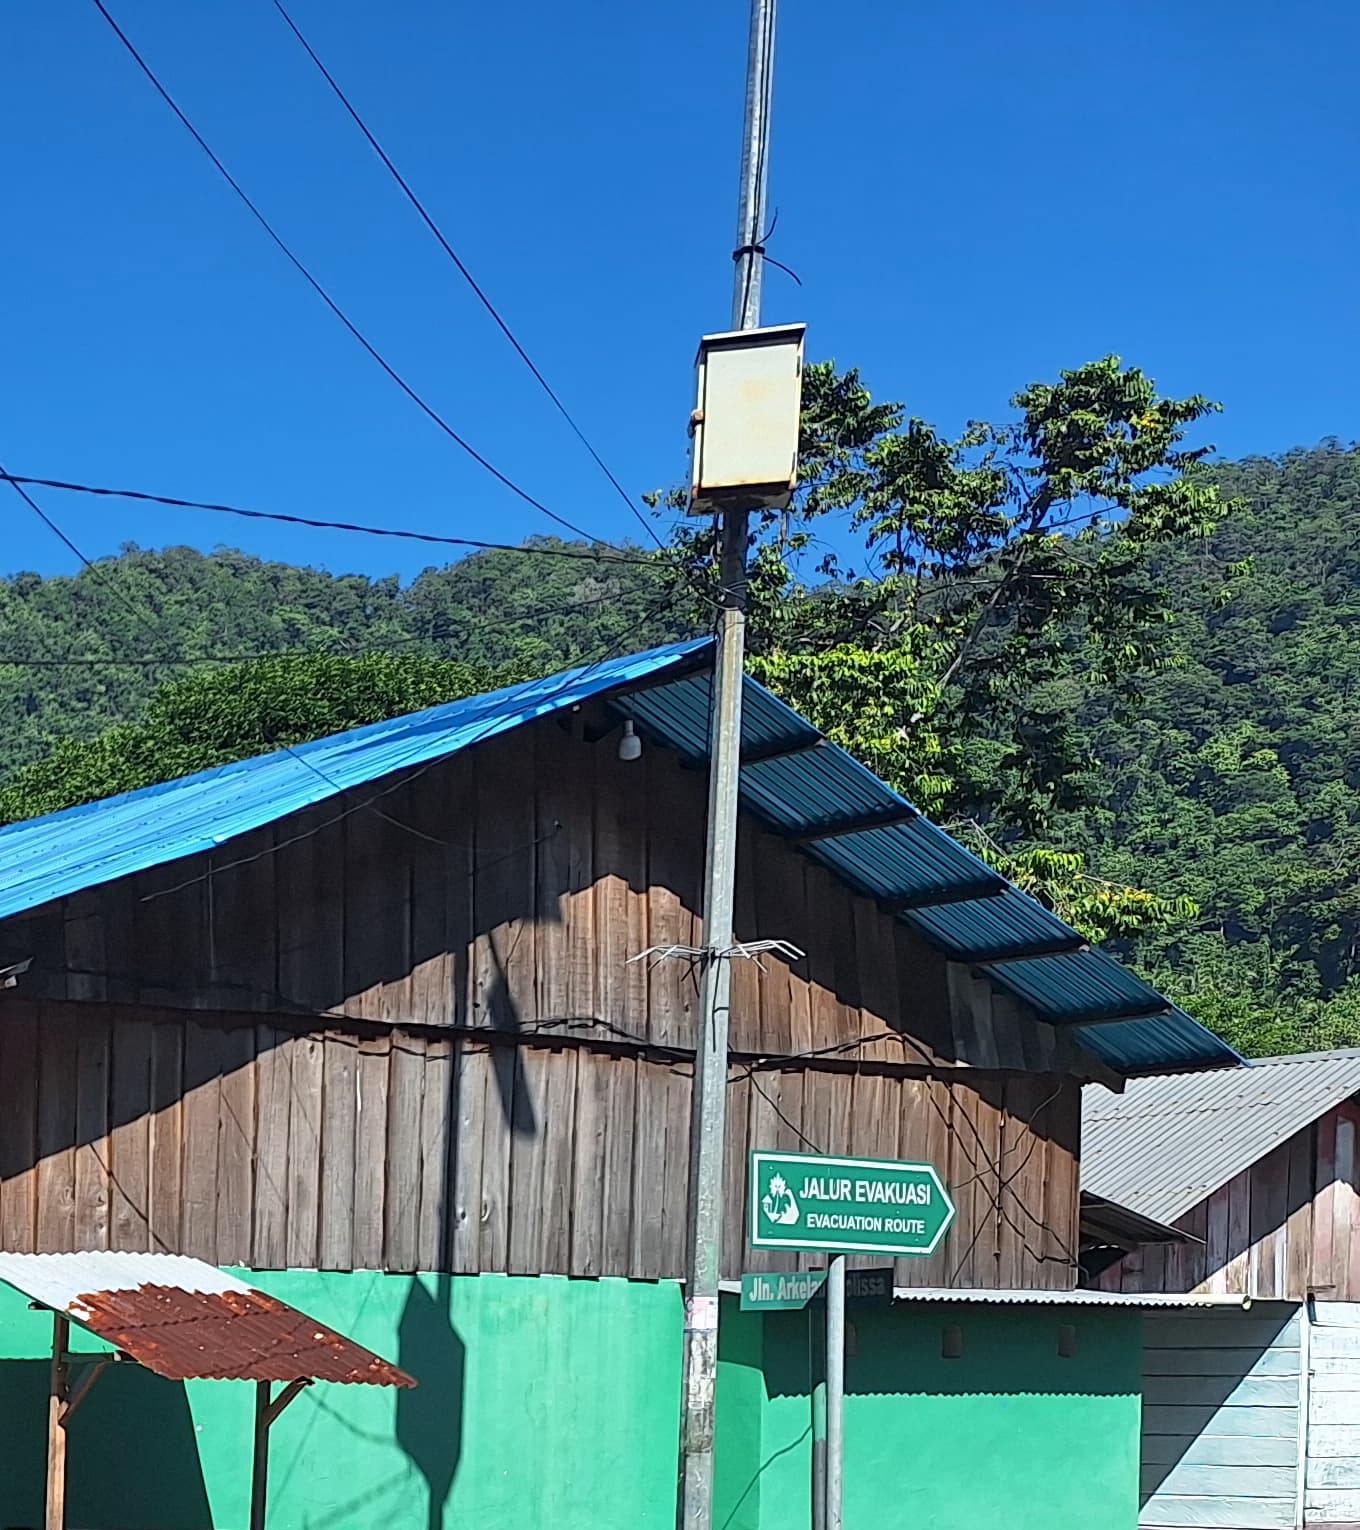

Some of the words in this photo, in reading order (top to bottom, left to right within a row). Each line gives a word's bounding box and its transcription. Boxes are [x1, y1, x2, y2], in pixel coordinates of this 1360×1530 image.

[799, 1177, 852, 1201] JALUR
[855, 1180, 931, 1206] EVAKUASI
[806, 1213, 882, 1232] EVACUATION
[884, 1218, 925, 1234] ROUTE
[749, 1277, 774, 1302] Jln.
[845, 1273, 886, 1297] olissa
